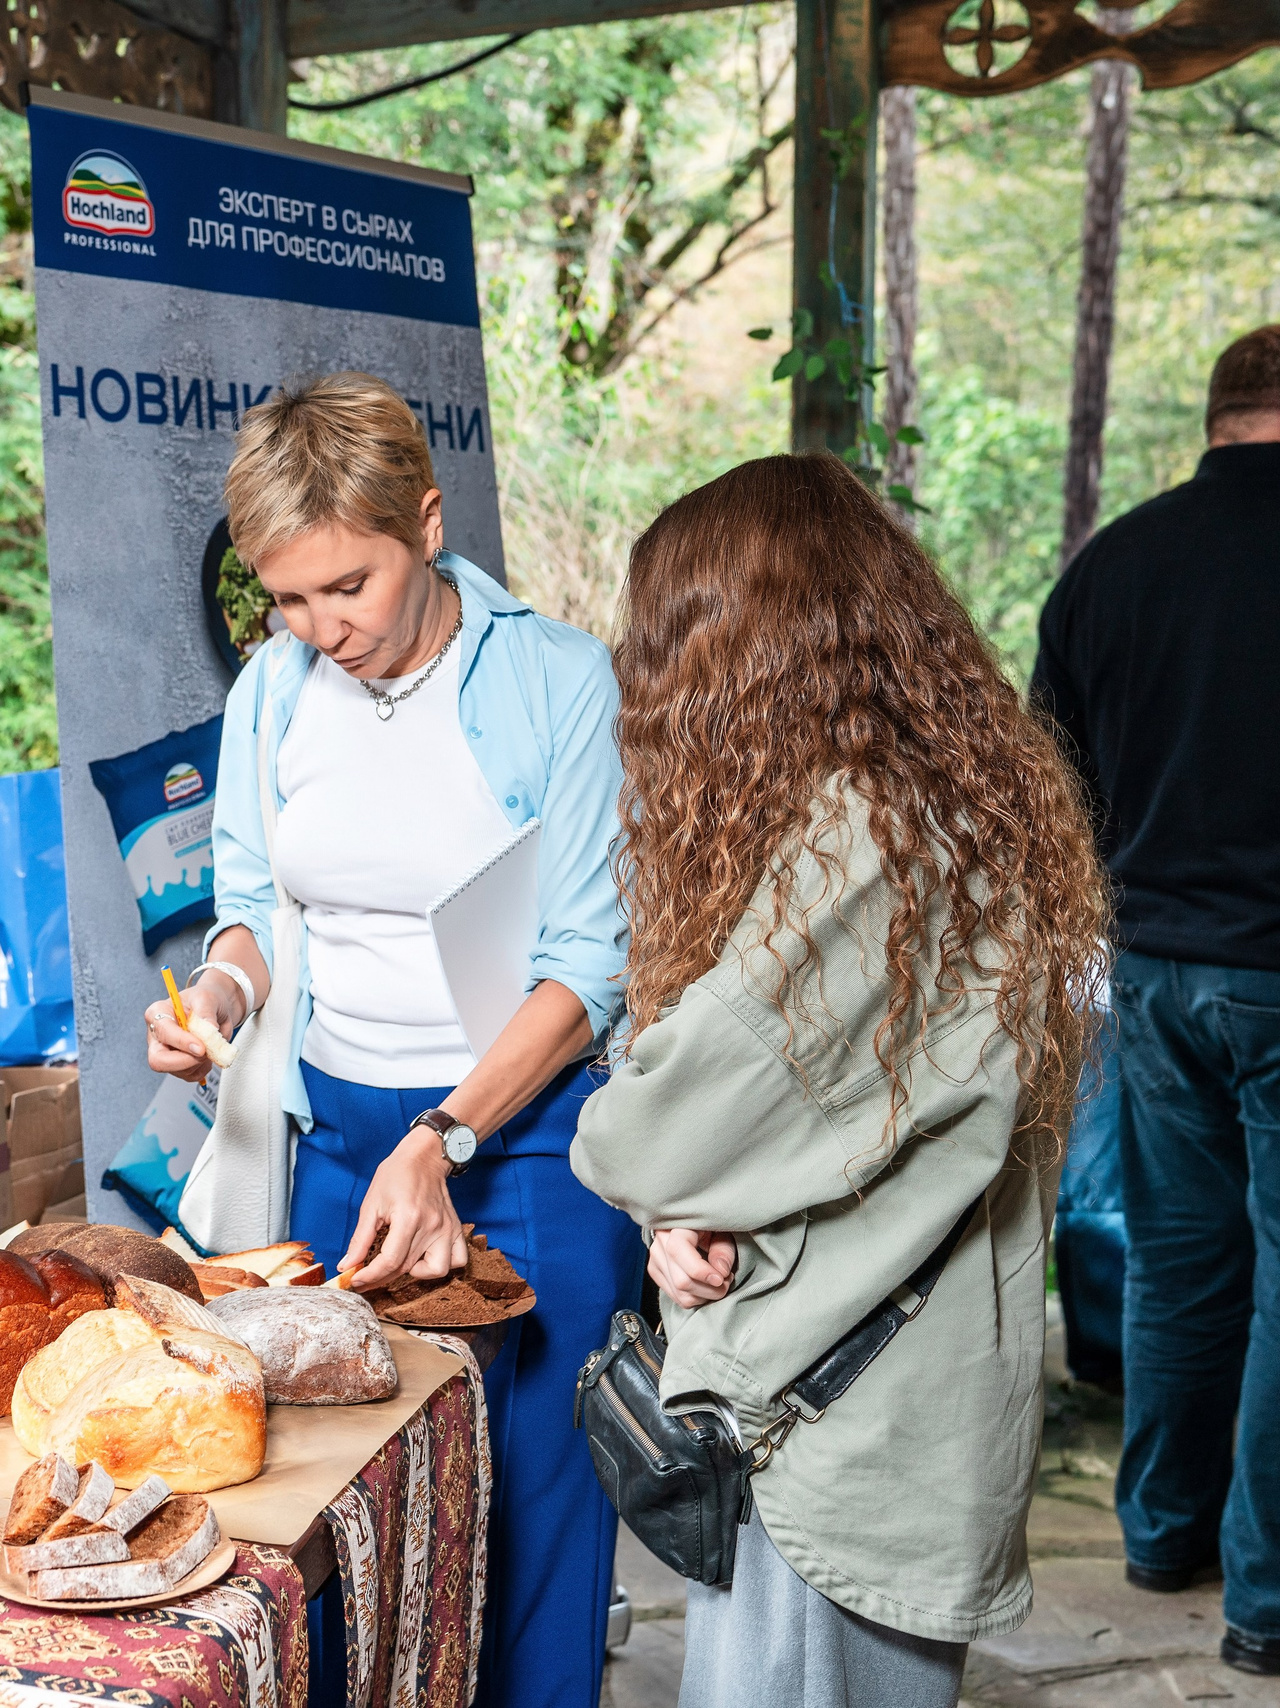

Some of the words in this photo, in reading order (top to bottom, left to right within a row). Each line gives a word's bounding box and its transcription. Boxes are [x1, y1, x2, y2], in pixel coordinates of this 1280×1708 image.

[70, 196, 147, 225] Hochland
[218, 186, 317, 228] ЭКСПЕРТ
[321, 205, 338, 231] В
[342, 209, 415, 246] СЫРАХ
[63, 231, 157, 257] PROFESSIONAL
[187, 217, 236, 250] ДЛЯ
[241, 226, 447, 283] ПРОФЕССИОНАЛОВ
[51, 363, 284, 432] НОВИНК
